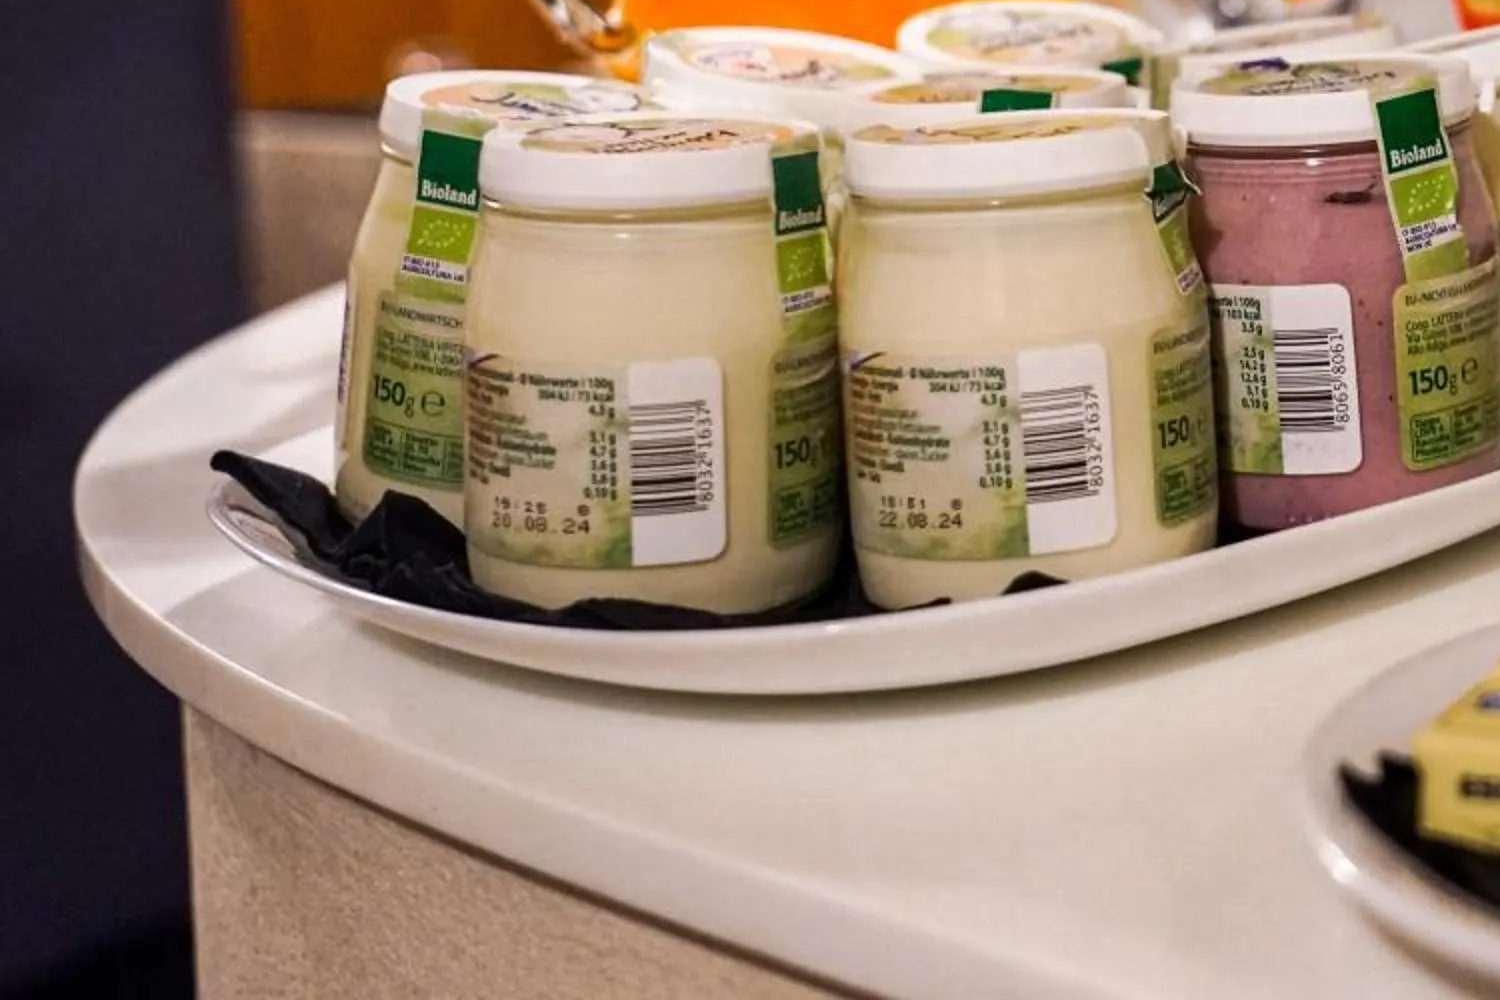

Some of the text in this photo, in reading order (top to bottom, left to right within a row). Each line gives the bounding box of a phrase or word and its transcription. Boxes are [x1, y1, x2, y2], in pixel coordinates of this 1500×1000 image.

[1390, 138, 1443, 168] Bioland
[421, 179, 477, 206] Bioland
[779, 204, 823, 231] Bioland
[1329, 333, 1351, 423] 8065 8061
[1409, 365, 1457, 396] 150g
[374, 374, 415, 418] 150g
[695, 404, 715, 503] 8032 1637
[1084, 389, 1104, 488] 8032 1637
[491, 511, 591, 535] 20.08.24
[879, 510, 963, 529] 22.08.24
